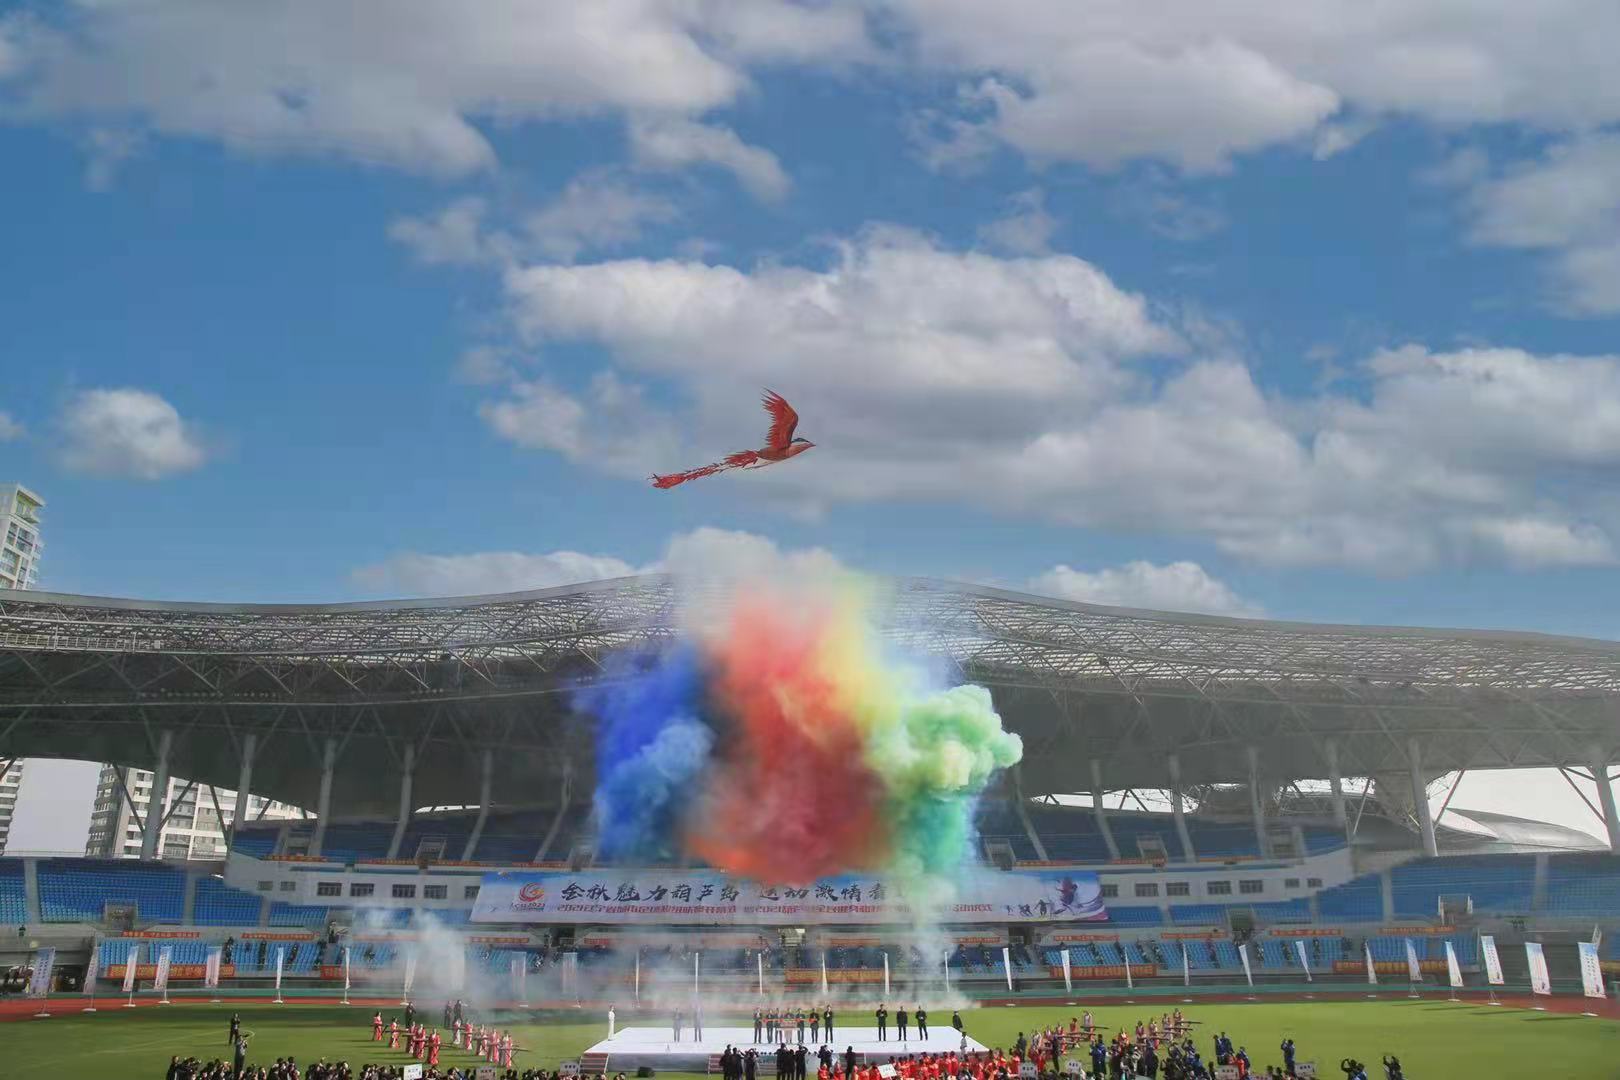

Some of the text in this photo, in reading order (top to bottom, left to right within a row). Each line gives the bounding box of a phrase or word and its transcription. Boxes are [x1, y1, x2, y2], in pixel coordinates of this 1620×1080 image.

[561, 881, 740, 902] 金秋魅力葫芦岛
